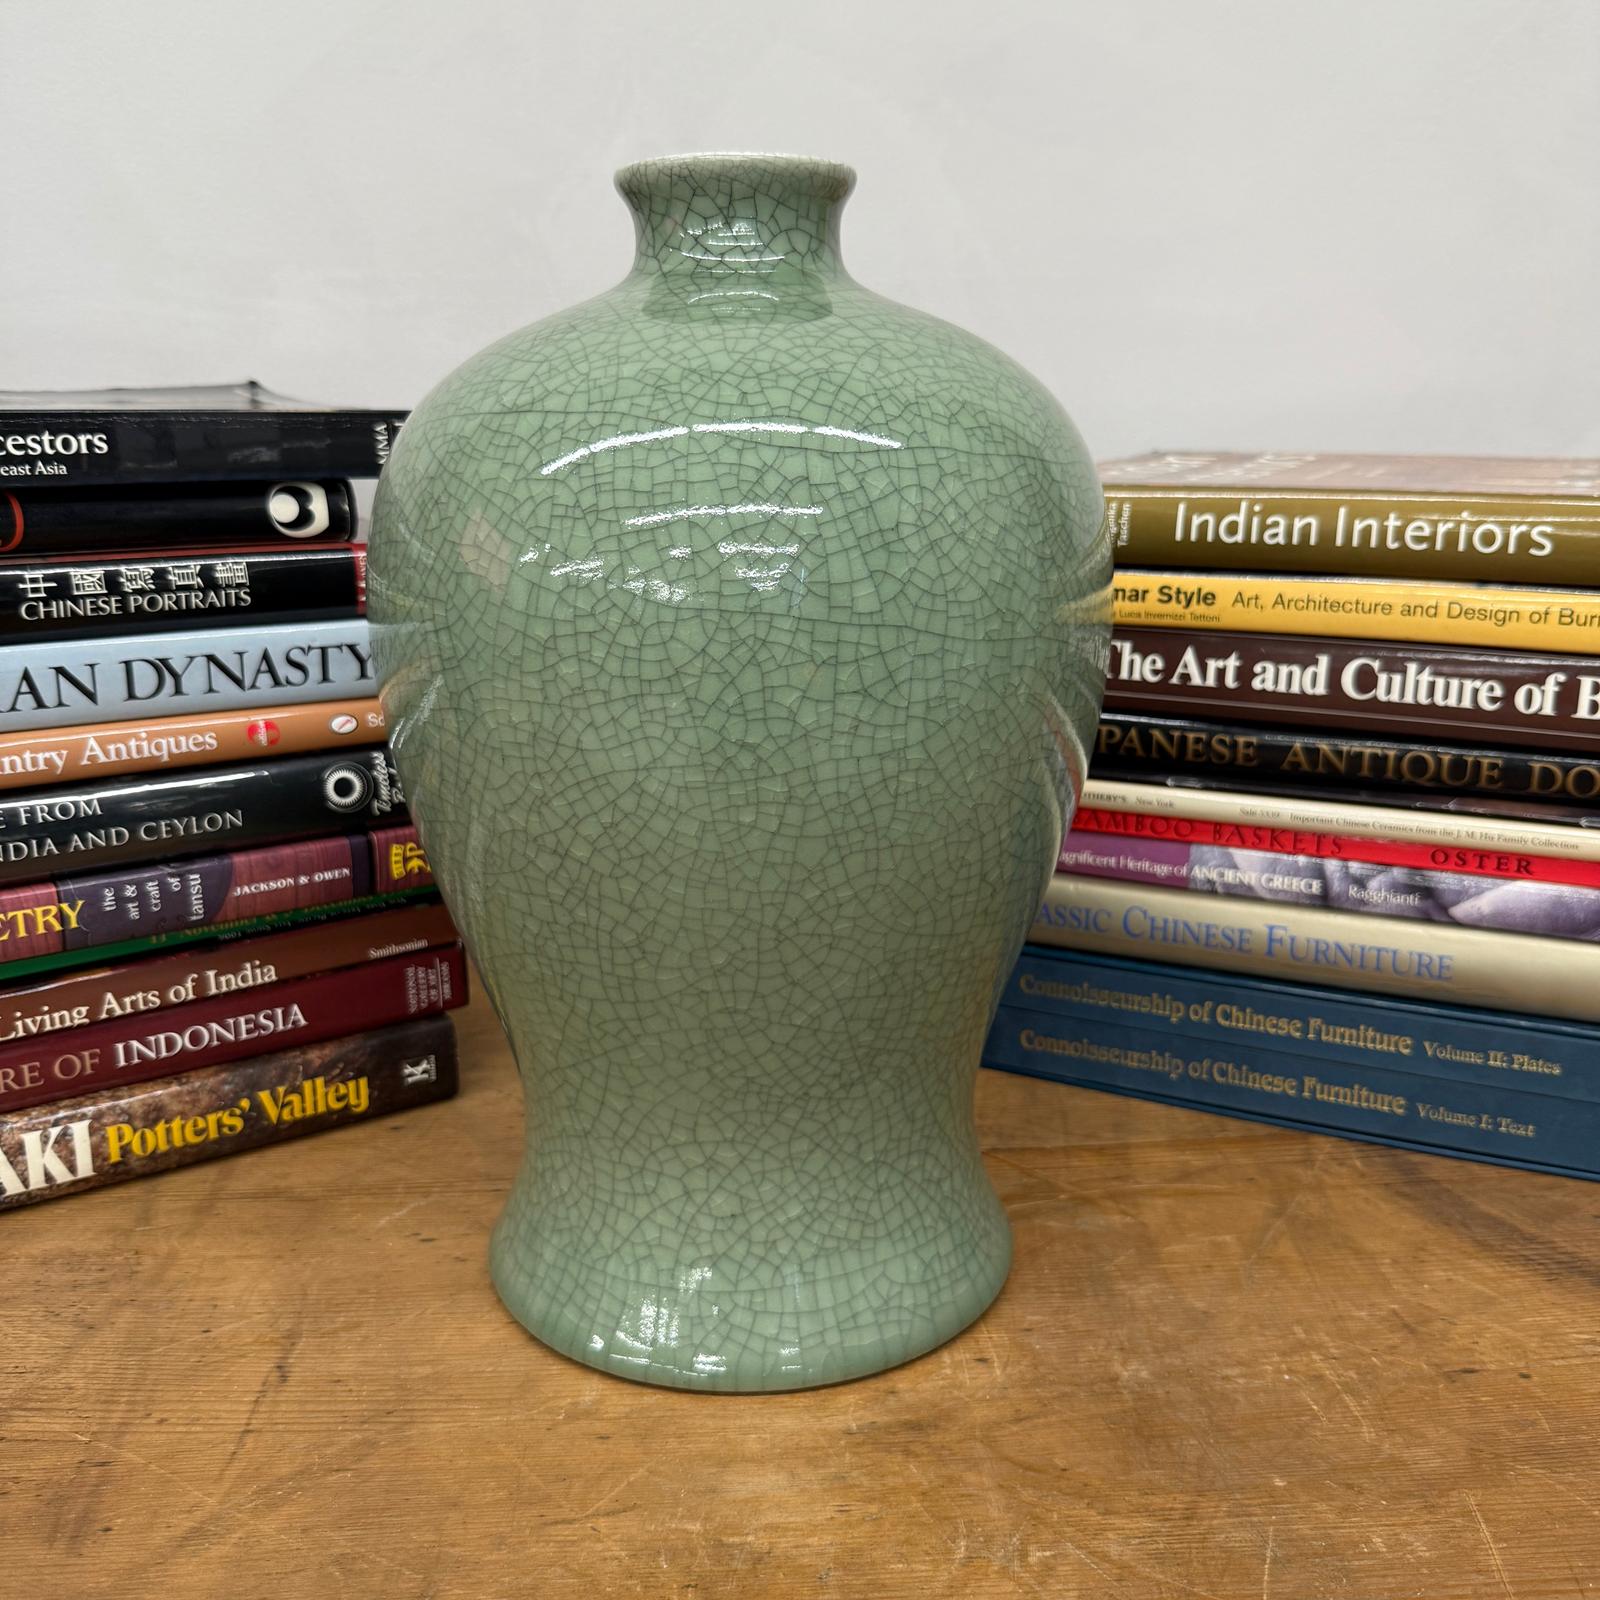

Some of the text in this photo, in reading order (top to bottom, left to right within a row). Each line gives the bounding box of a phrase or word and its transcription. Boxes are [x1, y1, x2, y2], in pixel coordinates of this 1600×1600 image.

[35, 460, 68, 475] Asia
[1174, 502, 1555, 557] Indian Interiors
[20, 588, 252, 621] CHINESE PORTRAITS
[1157, 585, 1217, 610] Style
[1231, 591, 1266, 611] Art,
[1272, 594, 1393, 617] Architecture
[1400, 602, 1439, 620] and
[1446, 602, 1521, 626] Design
[1529, 606, 1551, 625] of
[0, 643, 375, 713] AN DYNASTY
[1171, 645, 1241, 690] Art
[1250, 656, 1328, 696] and
[1340, 657, 1502, 712] Culture
[1514, 672, 1569, 717] of
[80, 732, 218, 765] Antiques
[1280, 742, 1505, 790] ANTIQUE
[18, 799, 103, 827] FROM
[69, 826, 130, 852] AND
[139, 808, 245, 842] CEYLON
[1213, 822, 1343, 856] BASKETS
[1119, 858, 1171, 877] Heritage
[1173, 863, 1189, 878] of
[1190, 865, 1257, 887] ANCIENT
[1261, 873, 1325, 896] GREECE
[1430, 848, 1534, 876] OSTER
[102, 886, 117, 912] the
[144, 879, 161, 912] craft
[167, 877, 182, 892] of
[187, 873, 205, 921] tansu
[233, 867, 350, 897] JACKSON & OWEN
[126, 901, 141, 920] art
[369, 933, 428, 959] Smithsonian
[1122, 905, 1252, 951] CHINESE
[1264, 923, 1456, 981] FURNITURE
[99, 991, 161, 1021] Arts
[168, 974, 200, 1001] of
[203, 961, 278, 996] India
[53, 1049, 101, 1080] OF
[113, 1003, 308, 1069] INDONESIA
[1019, 974, 1184, 1024] Connoisseurship
[1189, 1001, 1213, 1024] of
[1215, 1003, 1303, 1039] Chinese
[1307, 1016, 1414, 1056] Furniture
[1422, 1040, 1485, 1065] Volume
[1511, 1054, 1562, 1076] Plates
[1187, 1058, 1211, 1080] of
[1211, 1061, 1297, 1095] Chinese
[1302, 1076, 1408, 1116] Furniture
[1415, 1103, 1477, 1127] Volume
[1496, 1117, 1537, 1138] Text
[105, 1102, 251, 1164] Potters'
[257, 1076, 370, 1127] Valley
